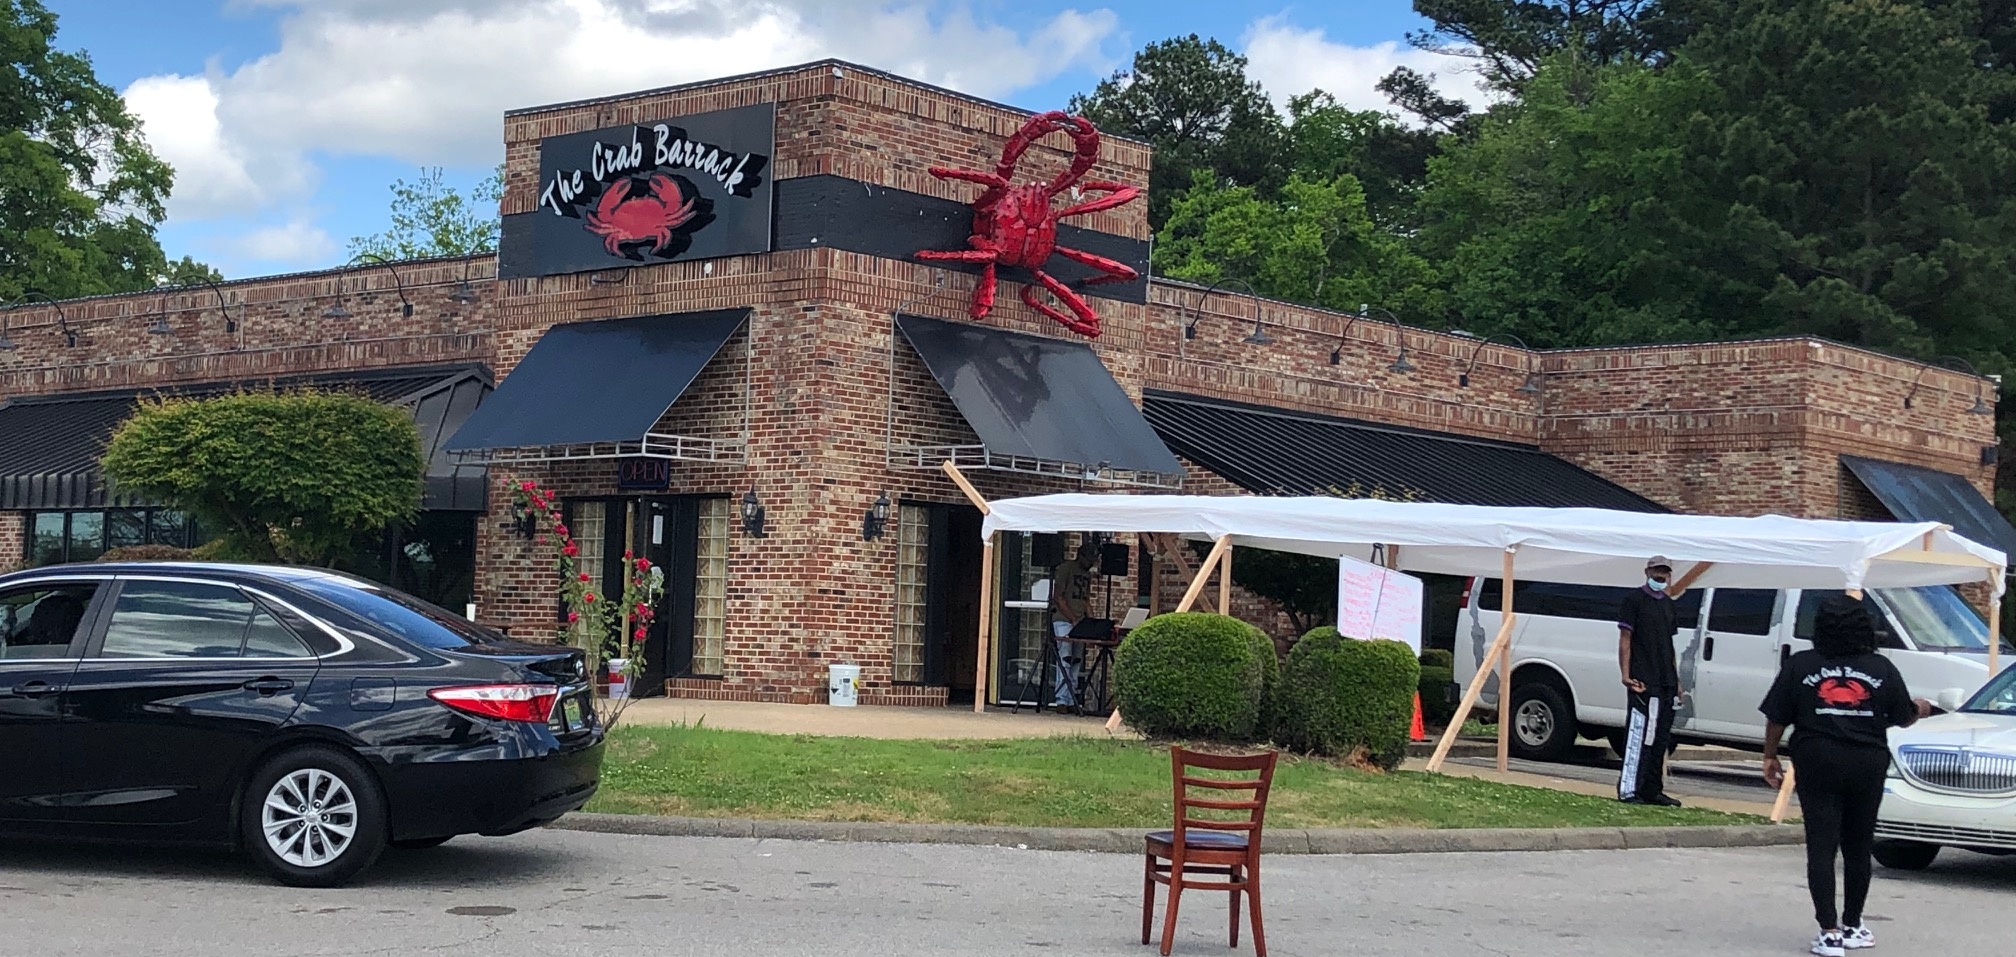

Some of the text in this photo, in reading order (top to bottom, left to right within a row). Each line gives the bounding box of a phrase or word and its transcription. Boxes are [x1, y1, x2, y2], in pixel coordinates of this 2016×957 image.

[540, 123, 750, 216] The Crab Barrack
[621, 460, 666, 480] OPEN
[1802, 674, 1820, 687] The
